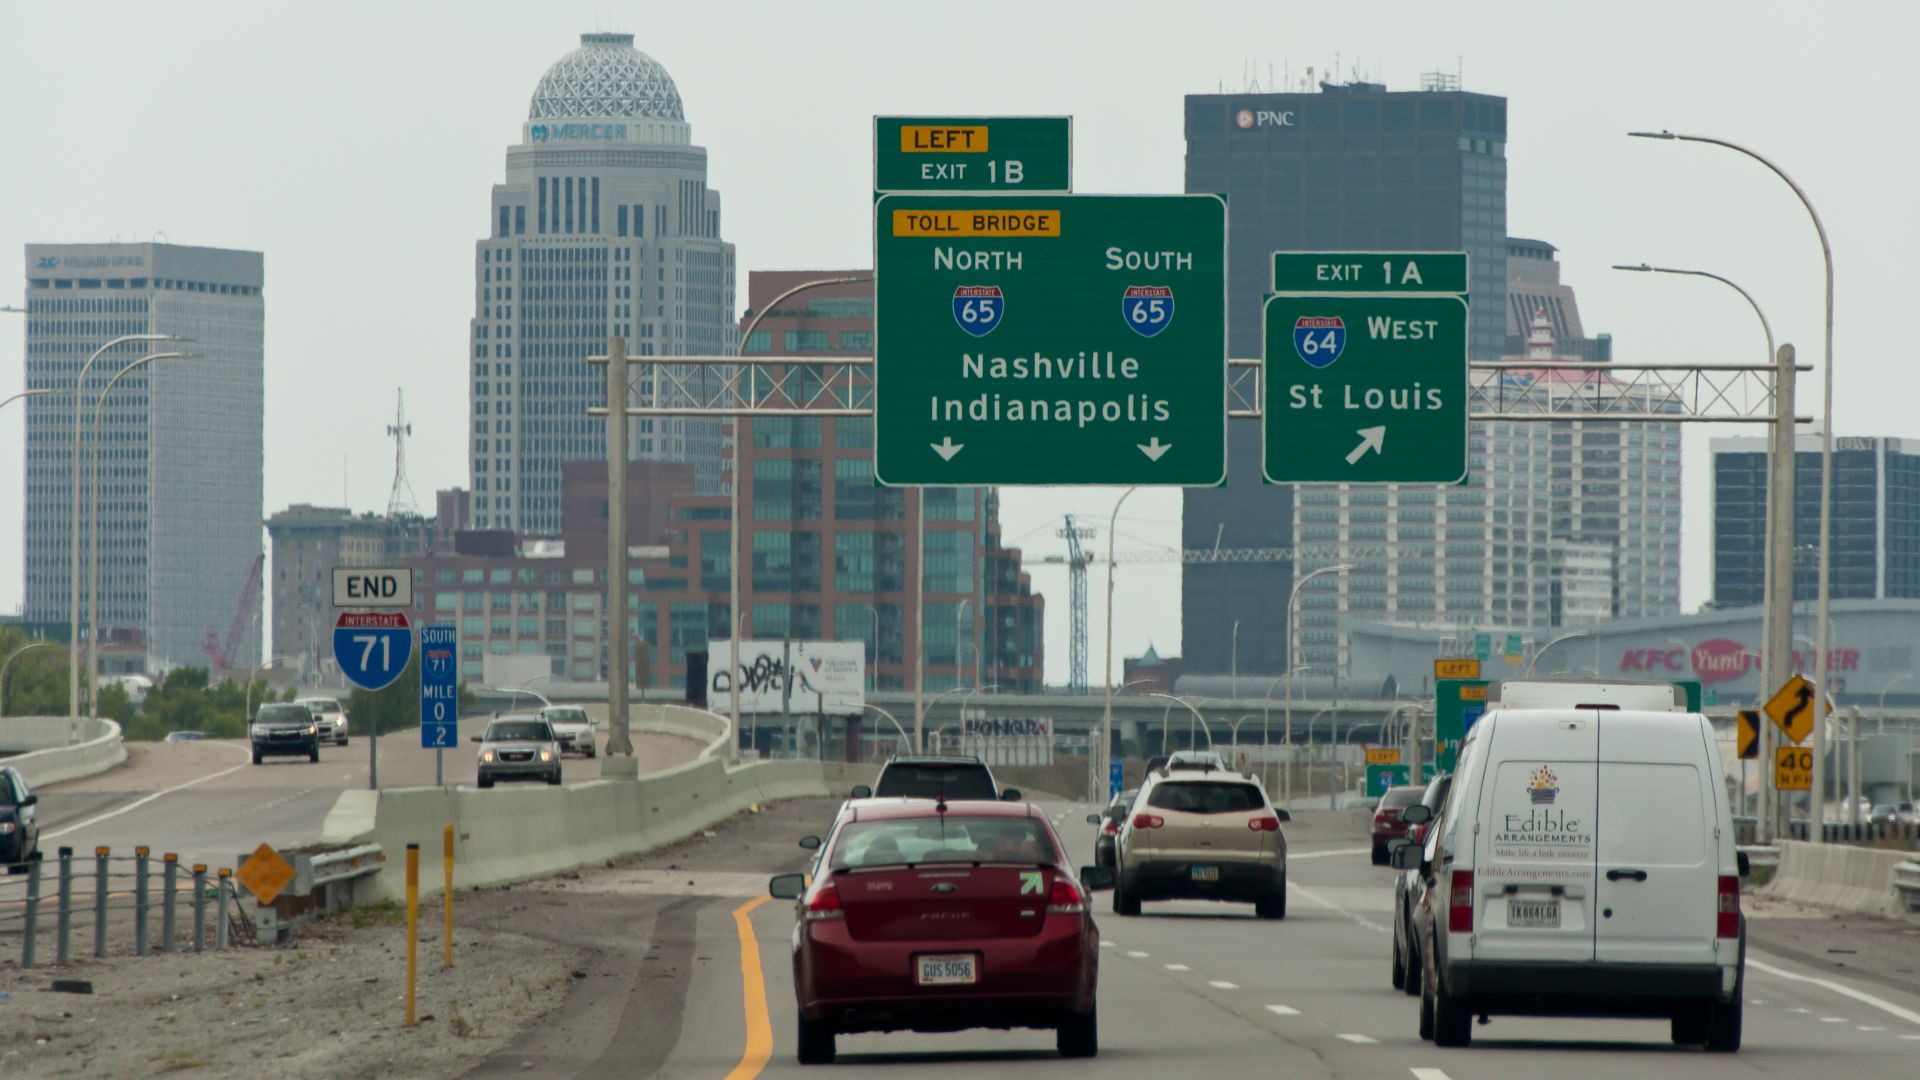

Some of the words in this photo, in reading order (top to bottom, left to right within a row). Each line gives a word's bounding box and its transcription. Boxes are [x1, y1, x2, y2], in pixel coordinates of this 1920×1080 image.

[1256, 111, 1295, 127] PNC
[551, 123, 627, 138] MERCER
[914, 130, 975, 148] LEFT
[921, 163, 967, 180] EXIT
[987, 159, 1024, 184] 1B
[907, 215, 960, 231] TOLL
[972, 215, 1050, 231] BRIDGE
[1316, 264, 1362, 281] EXIT
[1383, 261, 1423, 285] 1A
[960, 288, 996, 296] INTERSTATE
[1130, 288, 1167, 296] INTERSTATE
[962, 300, 995, 324] 65
[1132, 300, 1166, 324] 65
[1302, 318, 1338, 327] INTERSTATE
[1303, 330, 1336, 355] 64
[962, 351, 1139, 379] Nashville
[1289, 383, 1323, 409] St
[1344, 382, 1443, 410] Louis
[931, 393, 1170, 428] Indianapolis
[347, 575, 398, 599] END
[345, 615, 401, 628] INTERSTATE
[422, 629, 456, 644] SOUTH
[353, 635, 390, 673] 71
[1620, 648, 1686, 672] KFC
[1695, 649, 1745, 673] Yum!
[431, 660, 446, 673] 71
[423, 684, 455, 699] MILE
[434, 702, 445, 721] 0
[1780, 752, 1813, 771] 40
[1505, 809, 1578, 832] Edible
[1495, 833, 1591, 843] ARRANGEMENTS
[1477, 868, 1592, 879] EdibleArrangements.com
[923, 963, 943, 977] GUS
[945, 961, 971, 977] 5056
